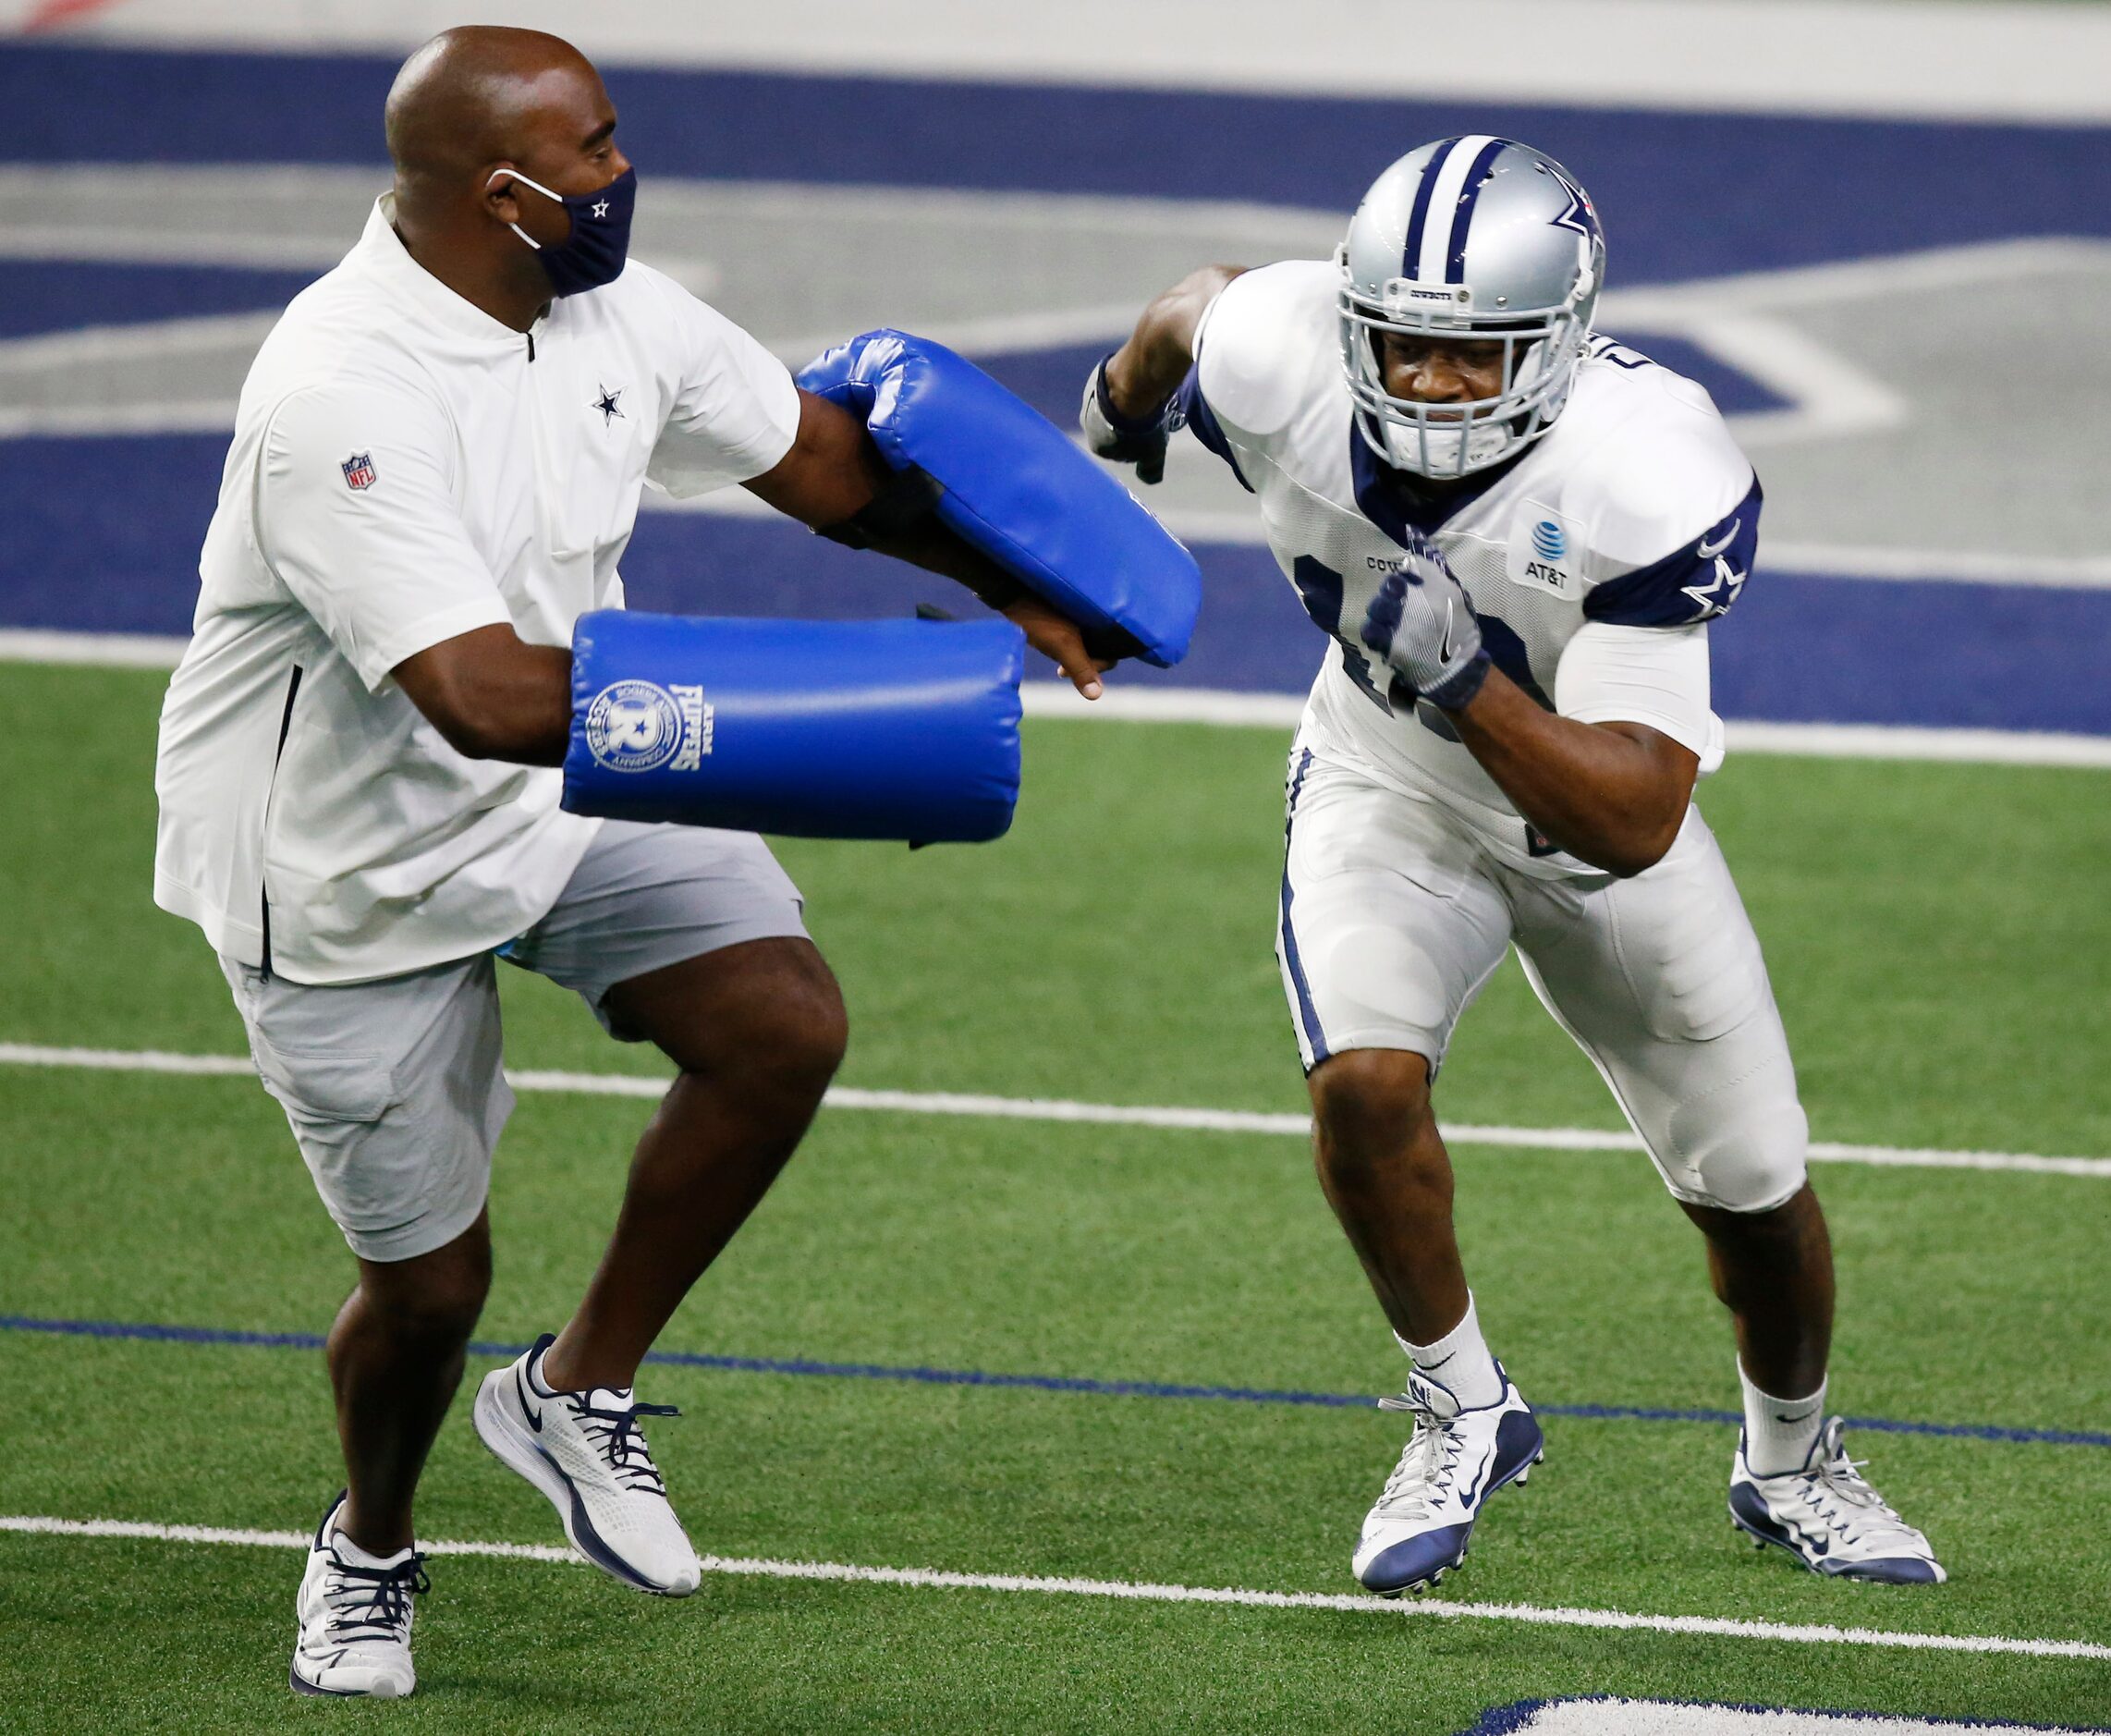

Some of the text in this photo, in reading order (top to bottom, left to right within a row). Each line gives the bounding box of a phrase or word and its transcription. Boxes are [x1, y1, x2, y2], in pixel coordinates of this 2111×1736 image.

[348, 468, 373, 487] NFL
[1525, 561, 1567, 590] AT&T
[668, 684, 703, 771] FLIPPERS
